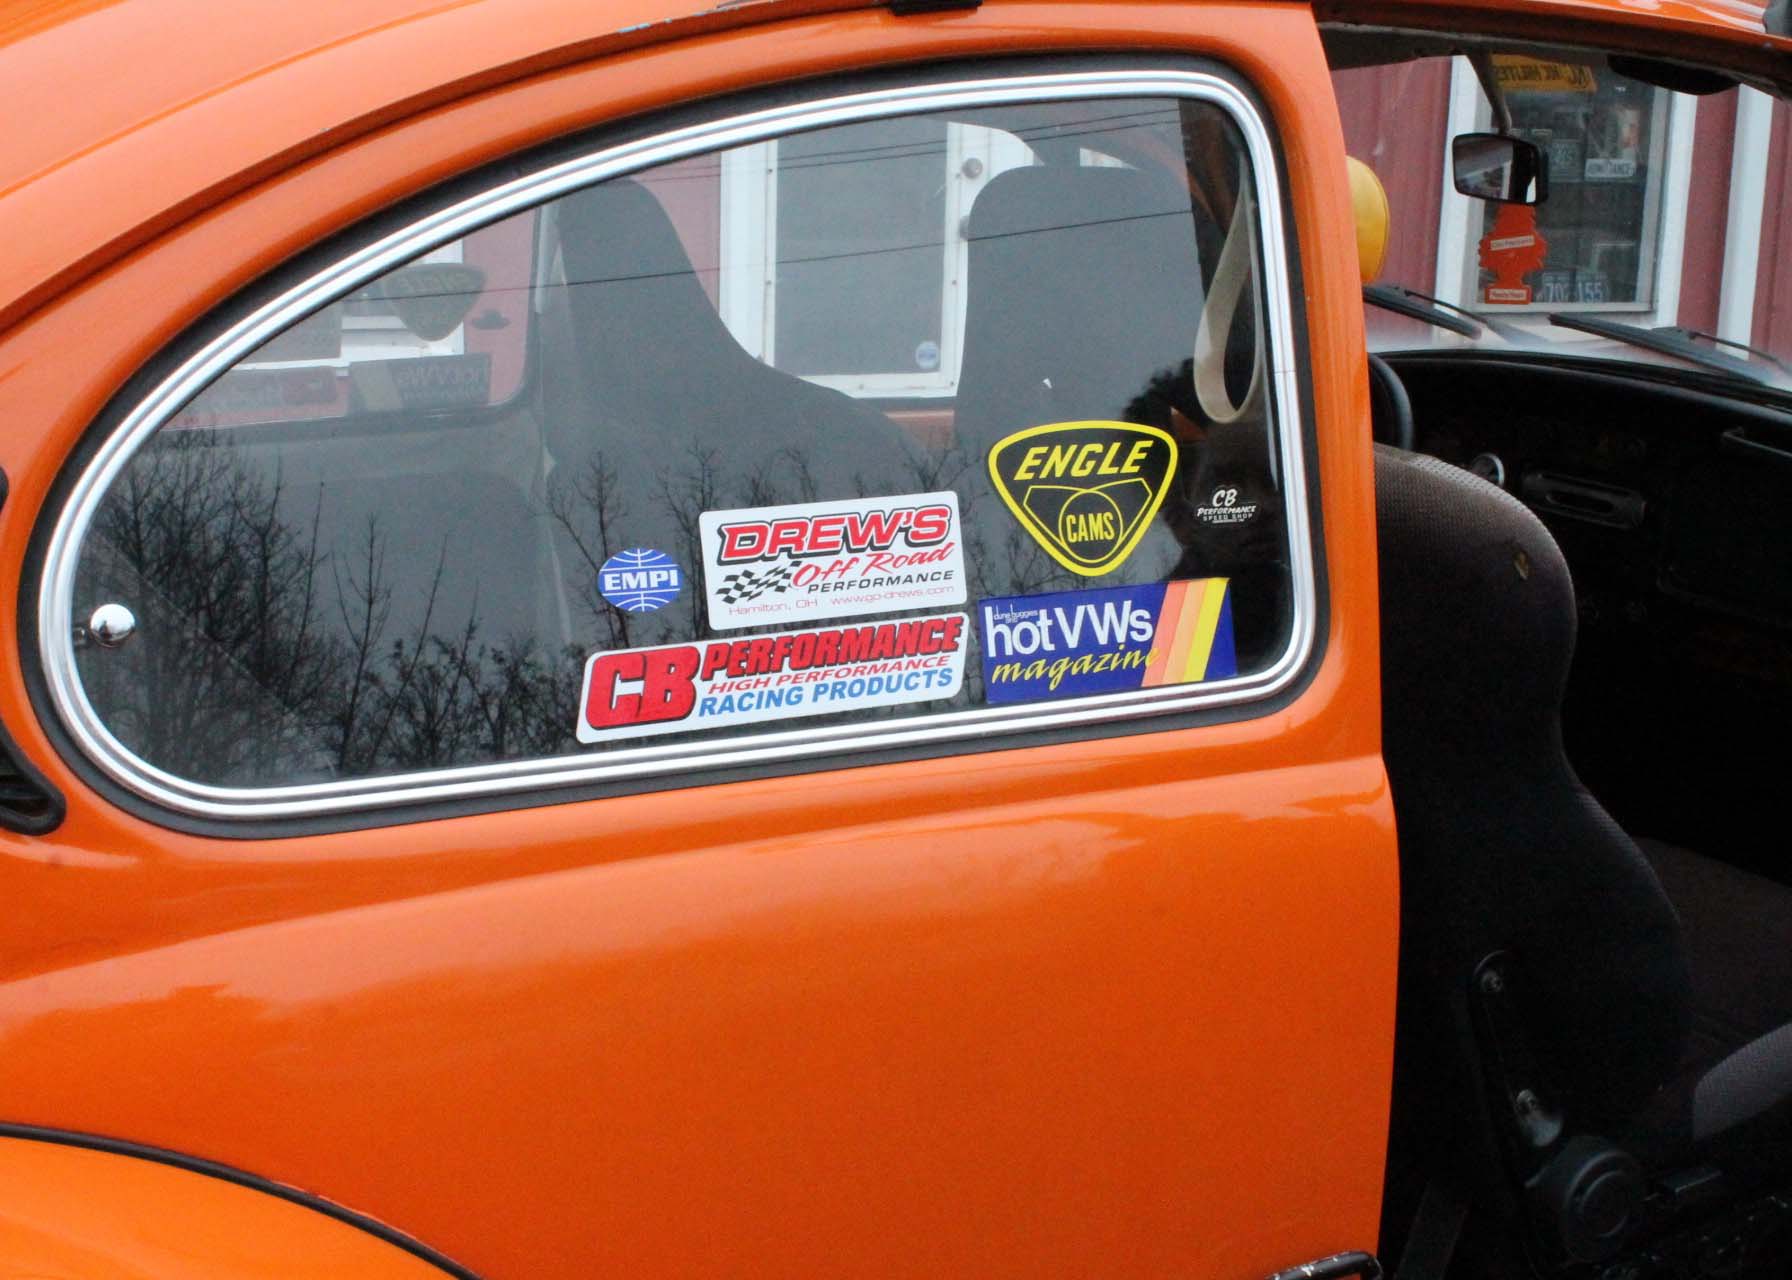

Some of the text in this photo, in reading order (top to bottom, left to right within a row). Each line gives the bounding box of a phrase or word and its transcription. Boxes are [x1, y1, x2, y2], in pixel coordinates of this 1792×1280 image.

[1013, 440, 1154, 481] ENGLE
[1197, 505, 1257, 517] PERFORMANCE
[1212, 488, 1238, 507] CB
[1232, 512, 1253, 520] SHOP
[717, 504, 952, 566] DREW'S
[1066, 513, 1115, 543] CAMS
[604, 569, 679, 591] EMPI
[793, 541, 954, 589] Off Road
[808, 570, 954, 595] PERFORMANCE
[795, 598, 818, 609] OH
[701, 616, 965, 681] PERFORMANCE
[991, 644, 1161, 691] magazine
[585, 645, 701, 730] CB
[699, 668, 954, 718] RACING PRODUCTS
[708, 655, 952, 695] HIGH PERFORMANCE
